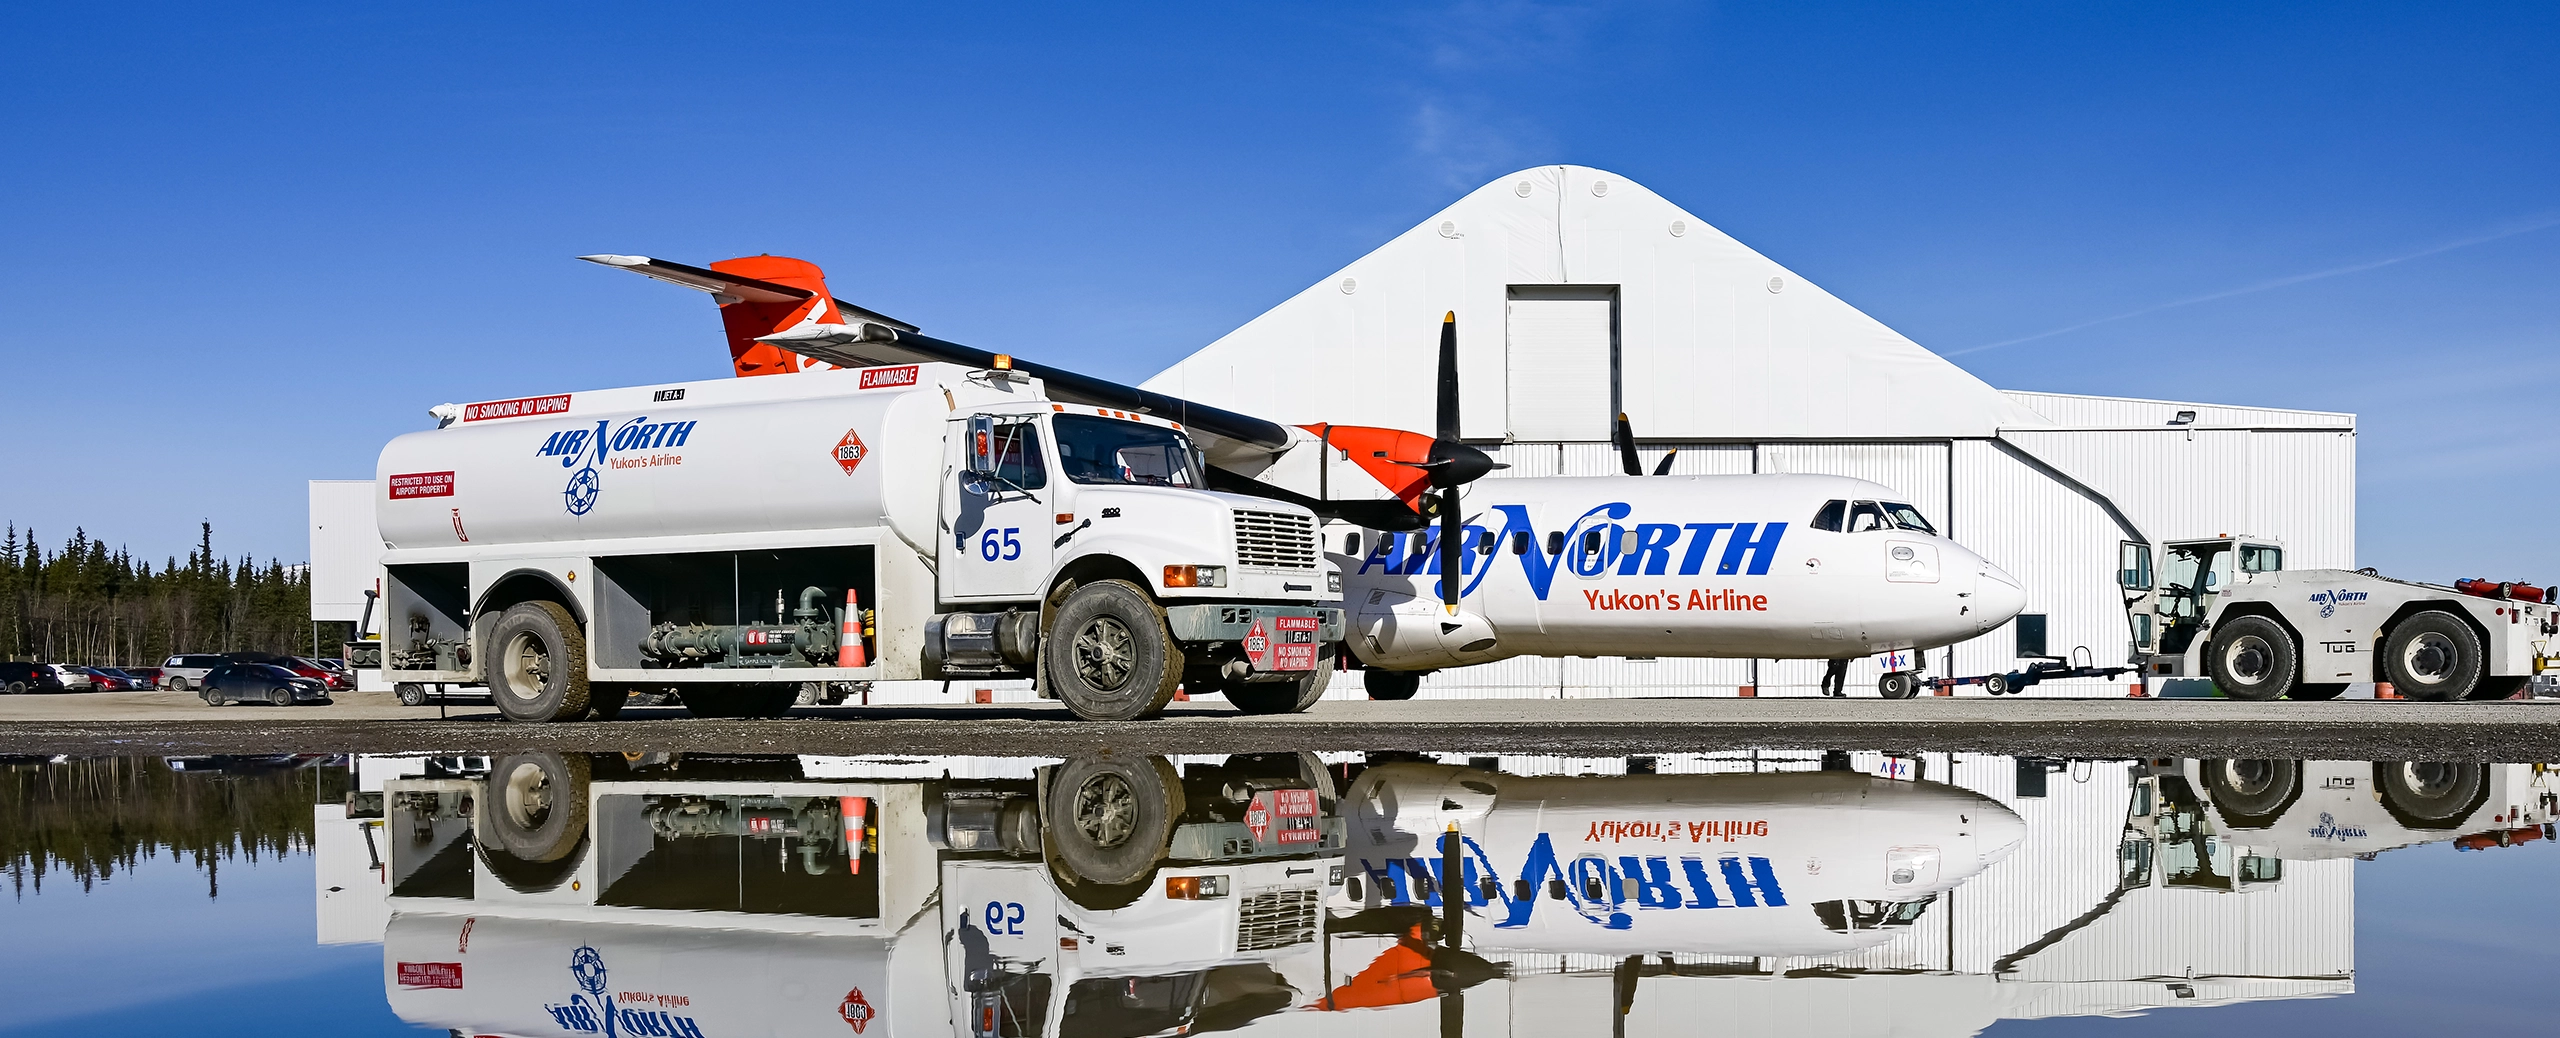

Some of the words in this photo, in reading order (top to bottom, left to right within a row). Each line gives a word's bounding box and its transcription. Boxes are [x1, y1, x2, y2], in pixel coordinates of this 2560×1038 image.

[861, 368, 916, 387] FLAMMABLE
[662, 390, 673, 401] JET
[672, 389, 684, 400] A-1
[465, 406, 479, 420] NO
[479, 401, 520, 419] SMOKING
[521, 400, 534, 414] NO
[536, 396, 569, 413] VAPING
[536, 429, 590, 457] AIR
[562, 415, 698, 468] NORTH
[840, 445, 860, 459] 1863
[610, 456, 647, 470] Yukon's
[649, 453, 682, 467] Airline
[846, 465, 853, 474] 3
[391, 476, 424, 487] RESTRICTED
[424, 475, 432, 485] TO
[432, 475, 443, 484] USE
[444, 474, 453, 483] ON
[395, 486, 419, 496] AIRPORT
[419, 484, 448, 495] PROPERTY
[981, 527, 1022, 562] 65
[1357, 524, 1490, 576] AIR
[1434, 502, 1789, 601] NORTH
[1583, 588, 1681, 612] Yukon's
[1686, 588, 1768, 611] Airline
[2308, 592, 2326, 603] AIR
[2319, 589, 2369, 605] NORTH
[1279, 619, 1316, 629] FLAMMABLE
[1293, 631, 1302, 642] JET
[1301, 631, 1311, 642] A-1
[1248, 638, 1265, 651] 1863
[1278, 646, 1287, 657] NO
[1287, 646, 1312, 657] SMOKING
[1280, 658, 1288, 667] NO
[1289, 658, 1308, 667] VAPING
[1880, 654, 1907, 669] VGX
